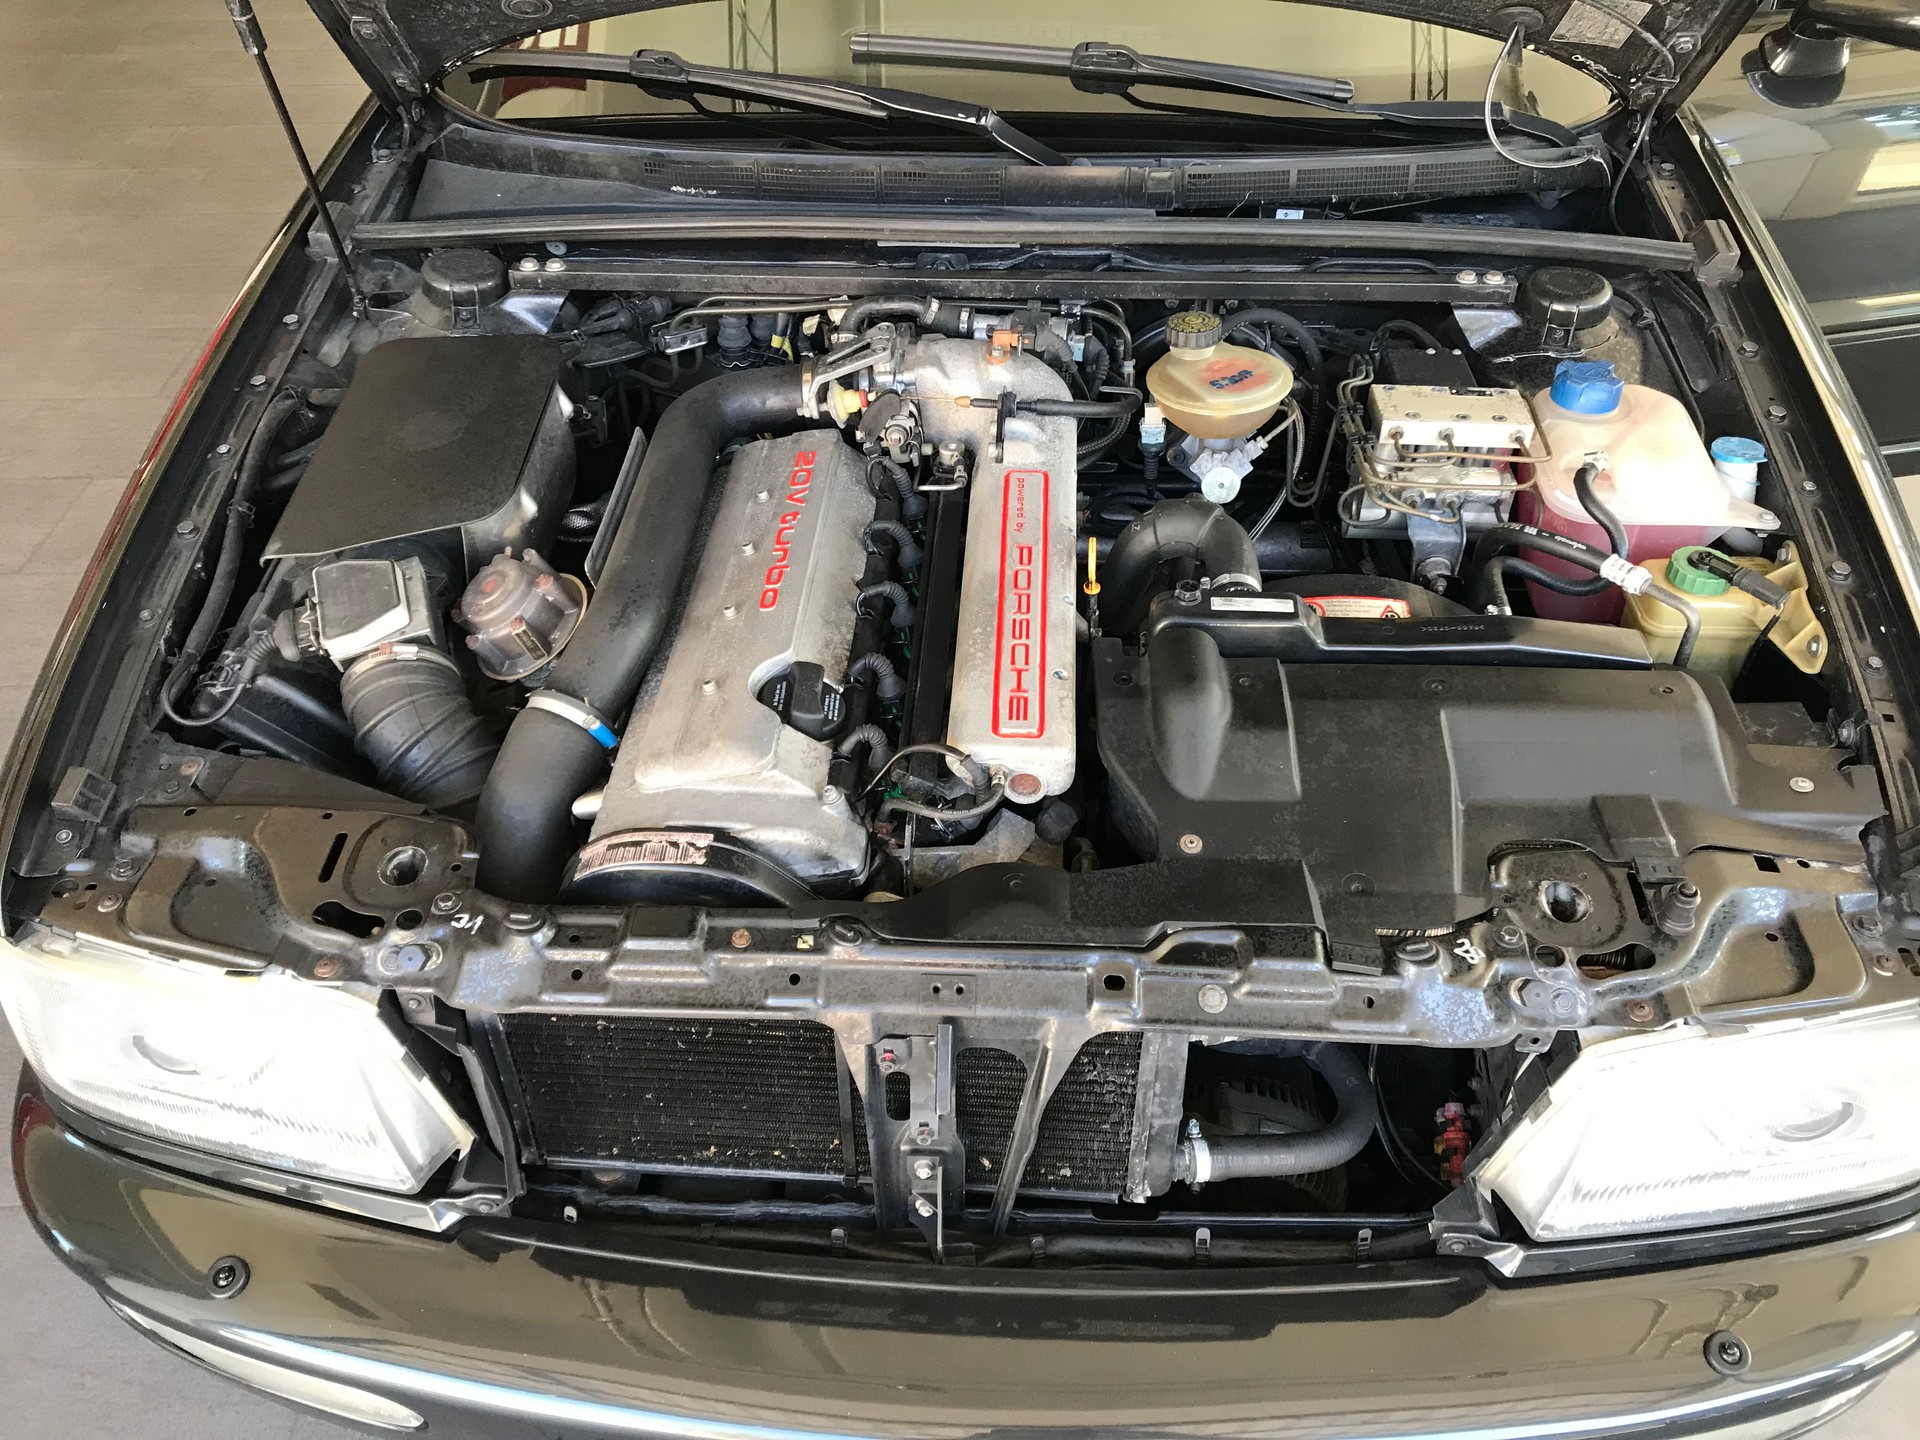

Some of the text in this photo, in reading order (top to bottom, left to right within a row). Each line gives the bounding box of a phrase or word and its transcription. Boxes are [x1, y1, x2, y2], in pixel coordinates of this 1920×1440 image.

[757, 449, 818, 610] 20V turbo
[1008, 476, 1034, 722] powered by PORSCHE
